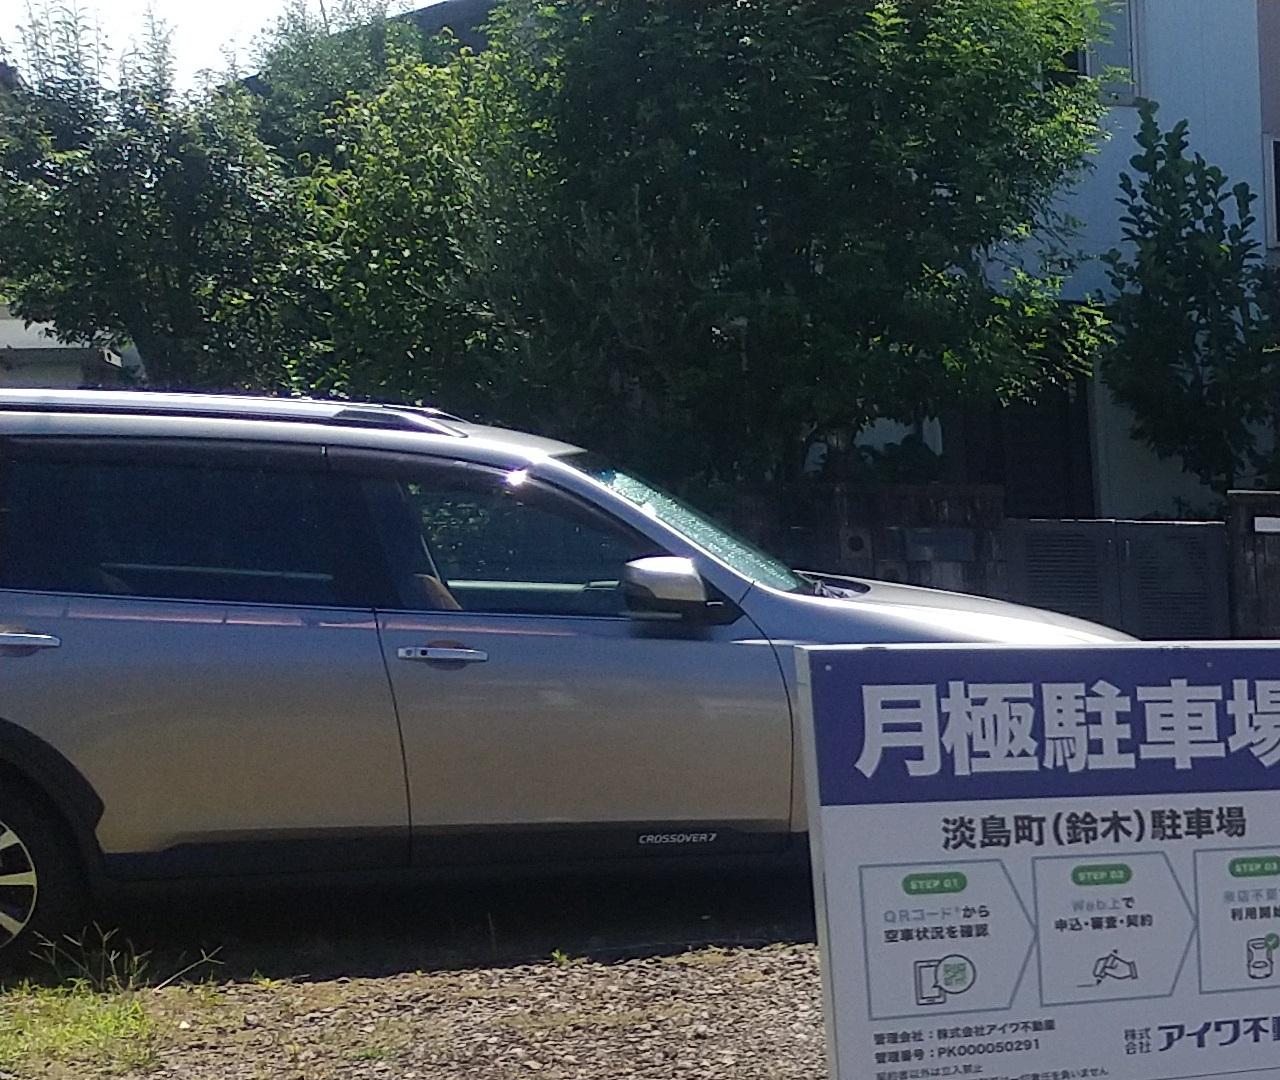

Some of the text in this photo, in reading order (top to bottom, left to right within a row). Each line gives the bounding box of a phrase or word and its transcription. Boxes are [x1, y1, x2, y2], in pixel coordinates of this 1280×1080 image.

[941, 806, 1247, 850] 淡島町(鈴木)駐車場
[884, 923, 990, 944] 空車状況を確認
